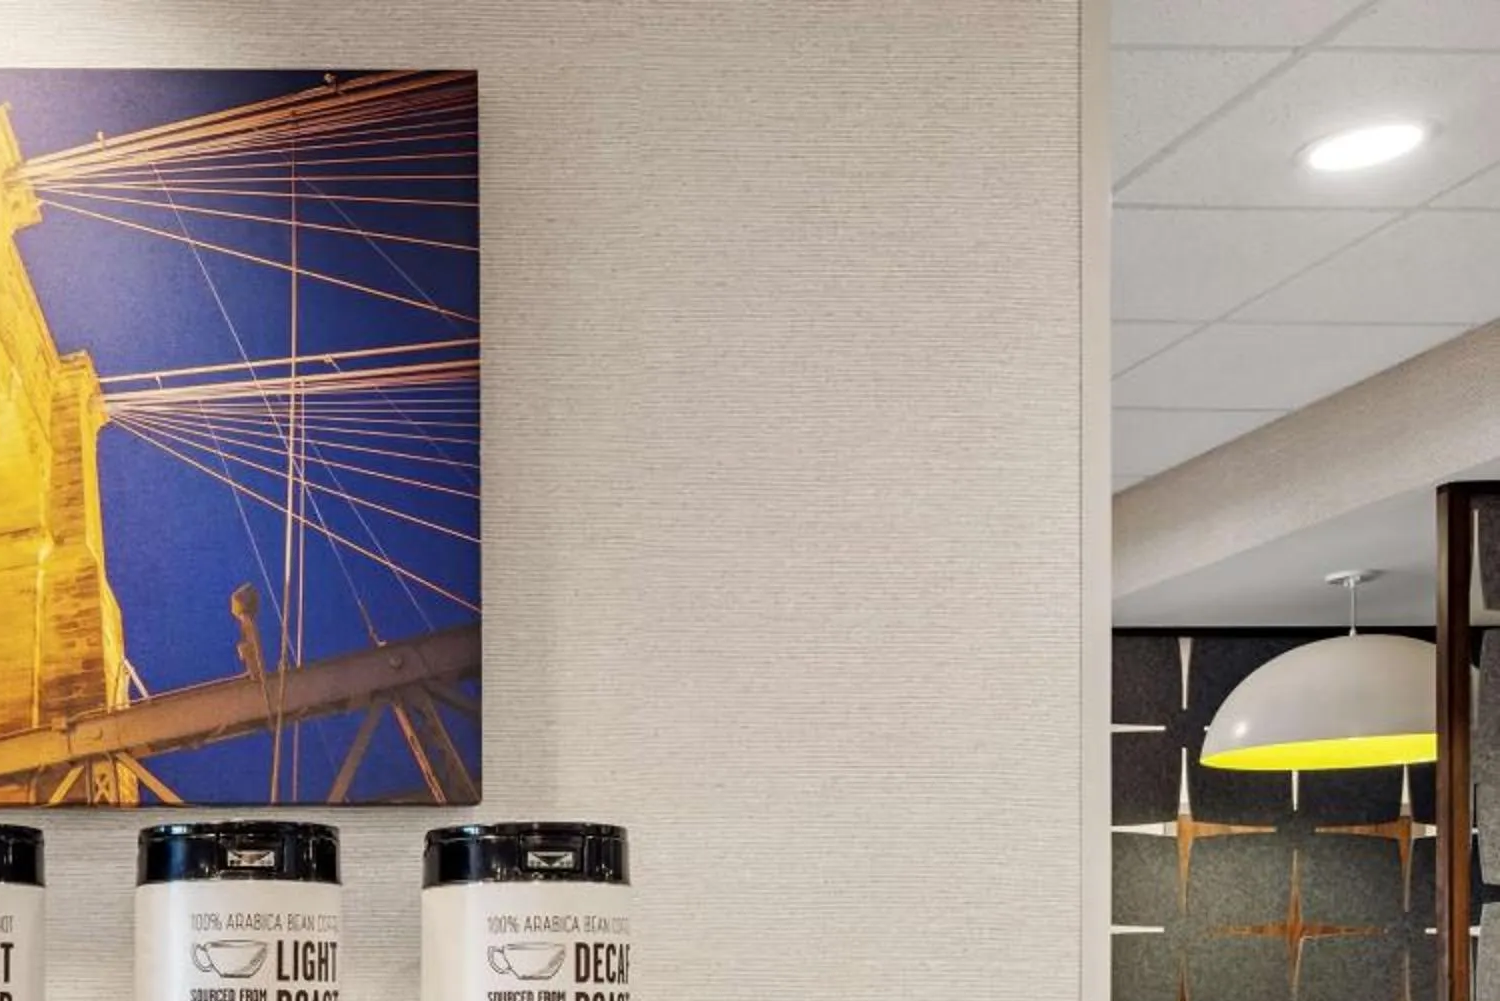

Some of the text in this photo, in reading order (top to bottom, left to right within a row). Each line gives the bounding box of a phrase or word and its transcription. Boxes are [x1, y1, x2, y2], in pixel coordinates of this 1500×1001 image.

[191, 913, 223, 932] 100%
[226, 913, 283, 932] ARABICA
[287, 913, 315, 932] BEAN
[486, 914, 520, 933] 100%
[524, 914, 581, 933] ARABICA
[276, 940, 338, 982] LIGHT
